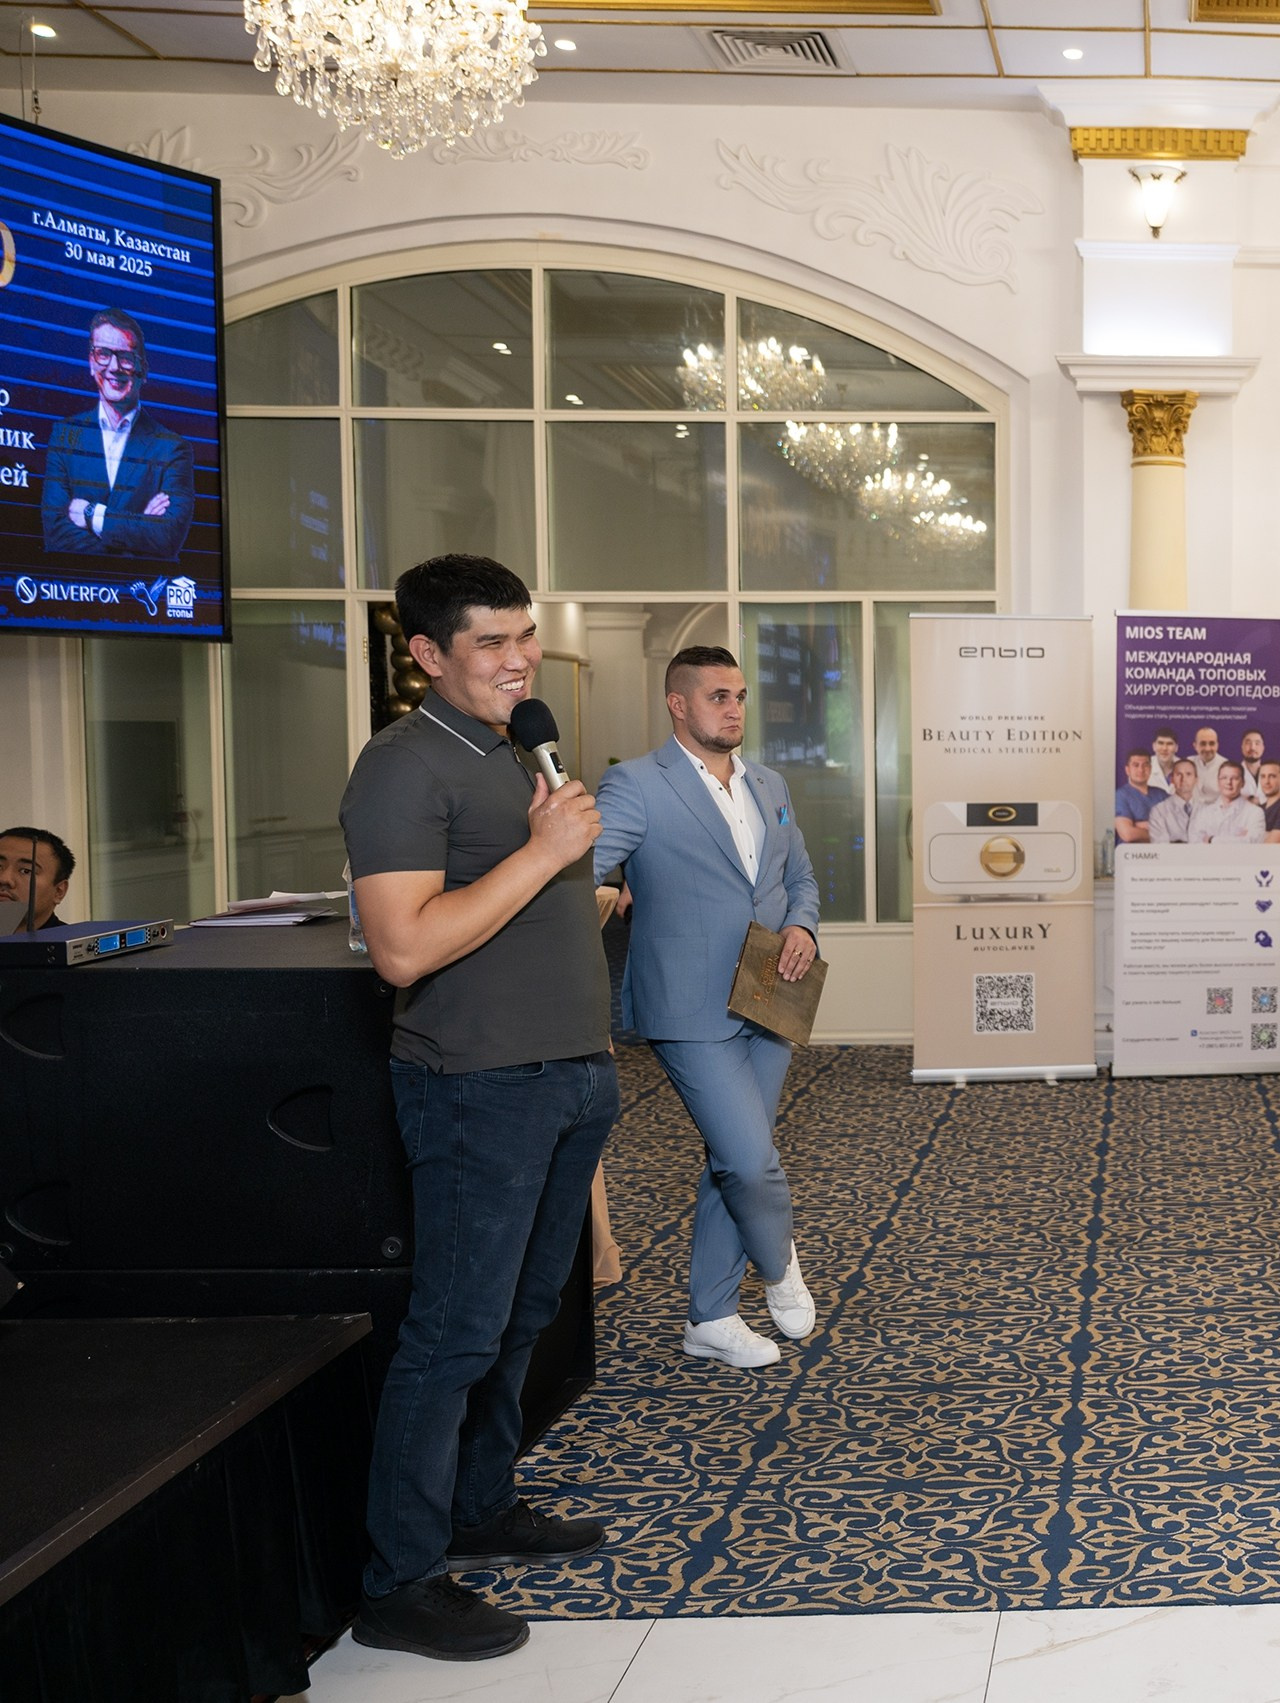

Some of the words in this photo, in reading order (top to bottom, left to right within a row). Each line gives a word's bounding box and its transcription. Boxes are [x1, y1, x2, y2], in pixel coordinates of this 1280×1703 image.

[32, 210, 110, 245] г.Алматы,
[114, 228, 191, 263] Казахстан
[65, 241, 83, 260] 30
[86, 249, 115, 269] мая
[119, 255, 153, 277] 2025
[40, 583, 120, 604] SILVERFOX
[168, 587, 192, 606] PRO
[1125, 625, 1163, 640] MIOS
[1166, 626, 1207, 641] TEAM
[1125, 651, 1251, 667] МЕЖДУНАРОДНАЯ
[1125, 667, 1195, 682] КОМАНДА
[1199, 668, 1267, 682] ТОПОВЫХ
[1124, 683, 1280, 699] ХИРУРГОВ-ОРТОПЕДОВ
[922, 727, 995, 742] BEAUTY
[1006, 727, 1083, 742] EDITION
[944, 746, 993, 754] MEDICAL
[998, 746, 1062, 754] STERILIZER
[956, 922, 1052, 941] LUXURY
